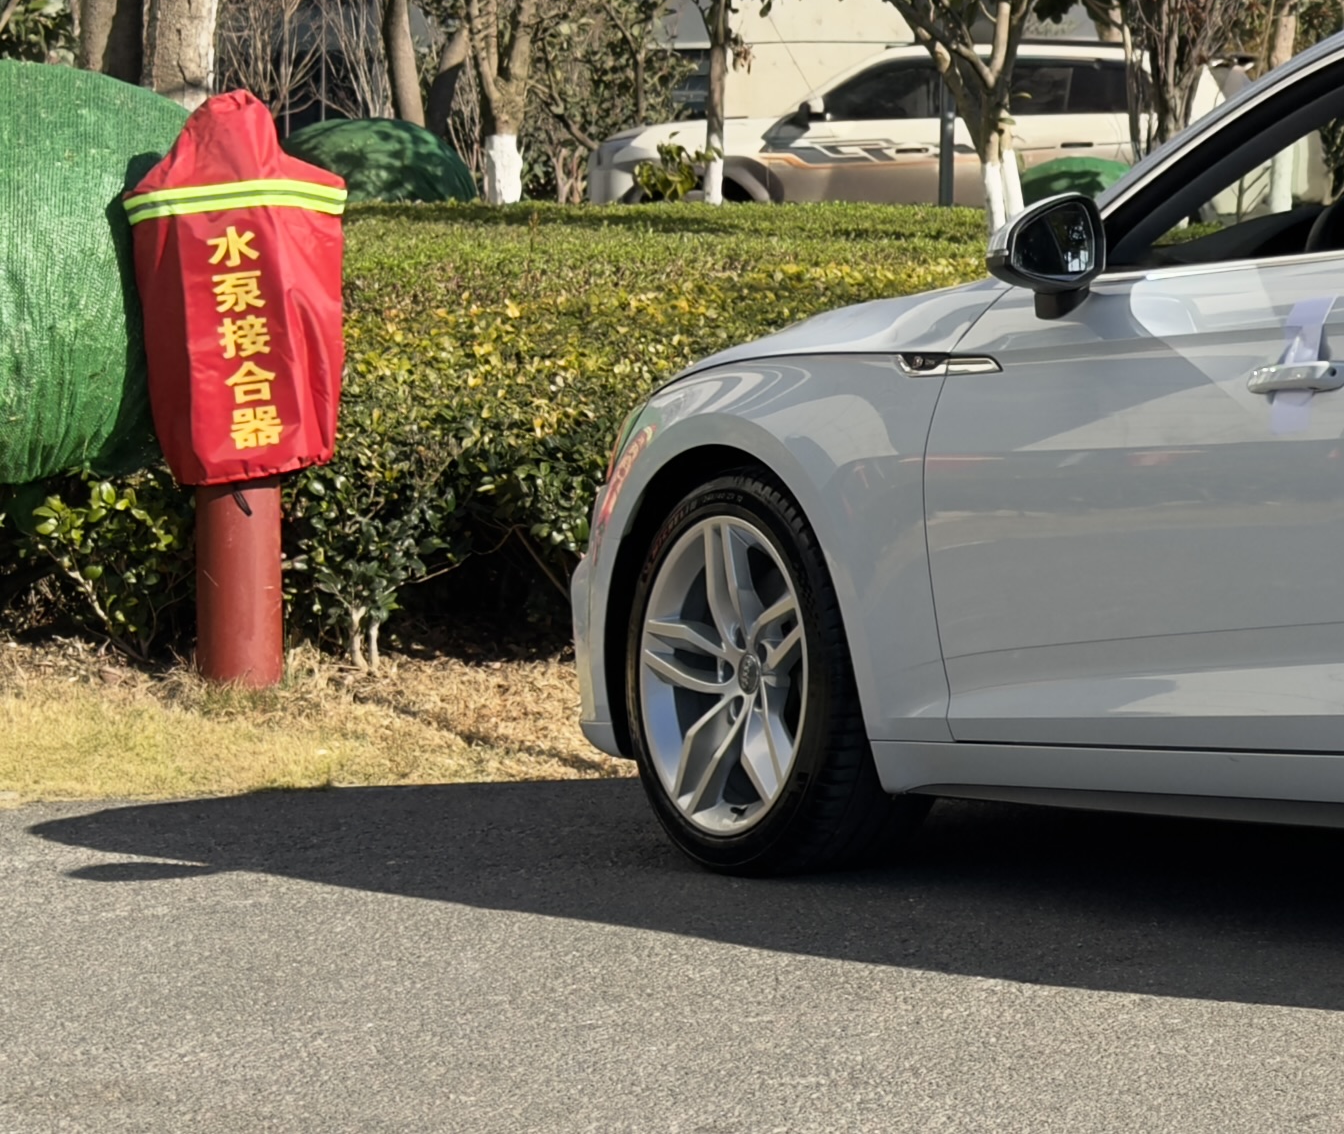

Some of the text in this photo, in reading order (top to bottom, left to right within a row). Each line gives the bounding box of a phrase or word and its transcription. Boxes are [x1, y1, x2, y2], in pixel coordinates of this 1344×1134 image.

[206, 225, 284, 451] 水泵接合器
